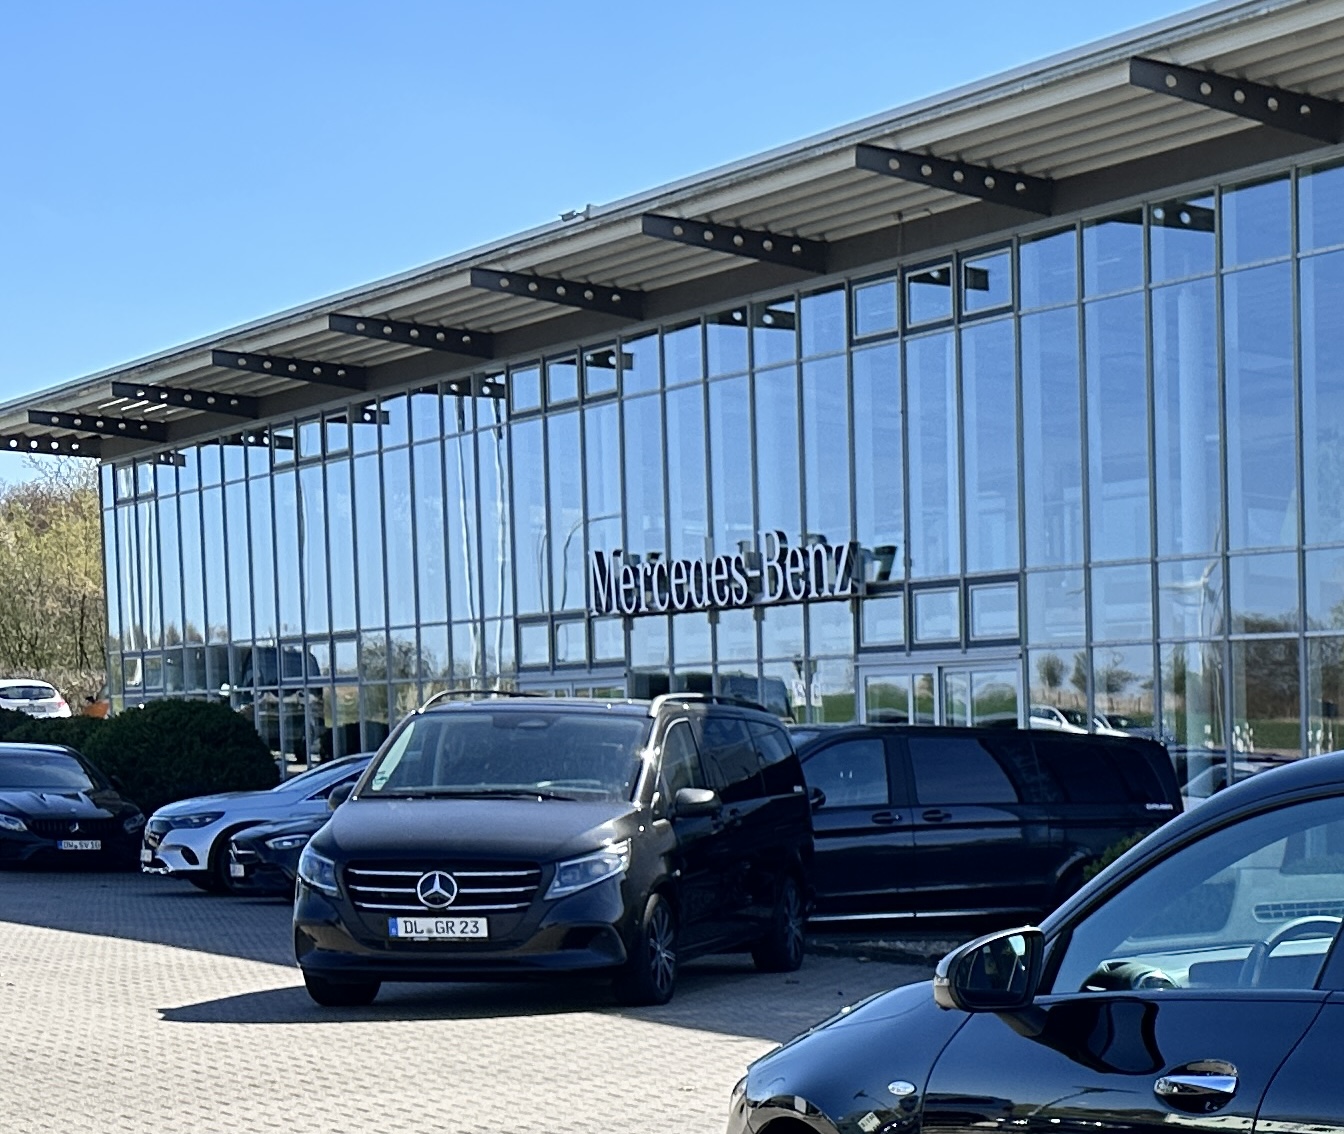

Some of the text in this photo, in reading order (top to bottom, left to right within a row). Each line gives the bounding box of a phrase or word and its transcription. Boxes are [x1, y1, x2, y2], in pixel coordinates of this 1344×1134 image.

[587, 529, 854, 616] Mercedes-Benz
[403, 920, 479, 934] DL GR 23
